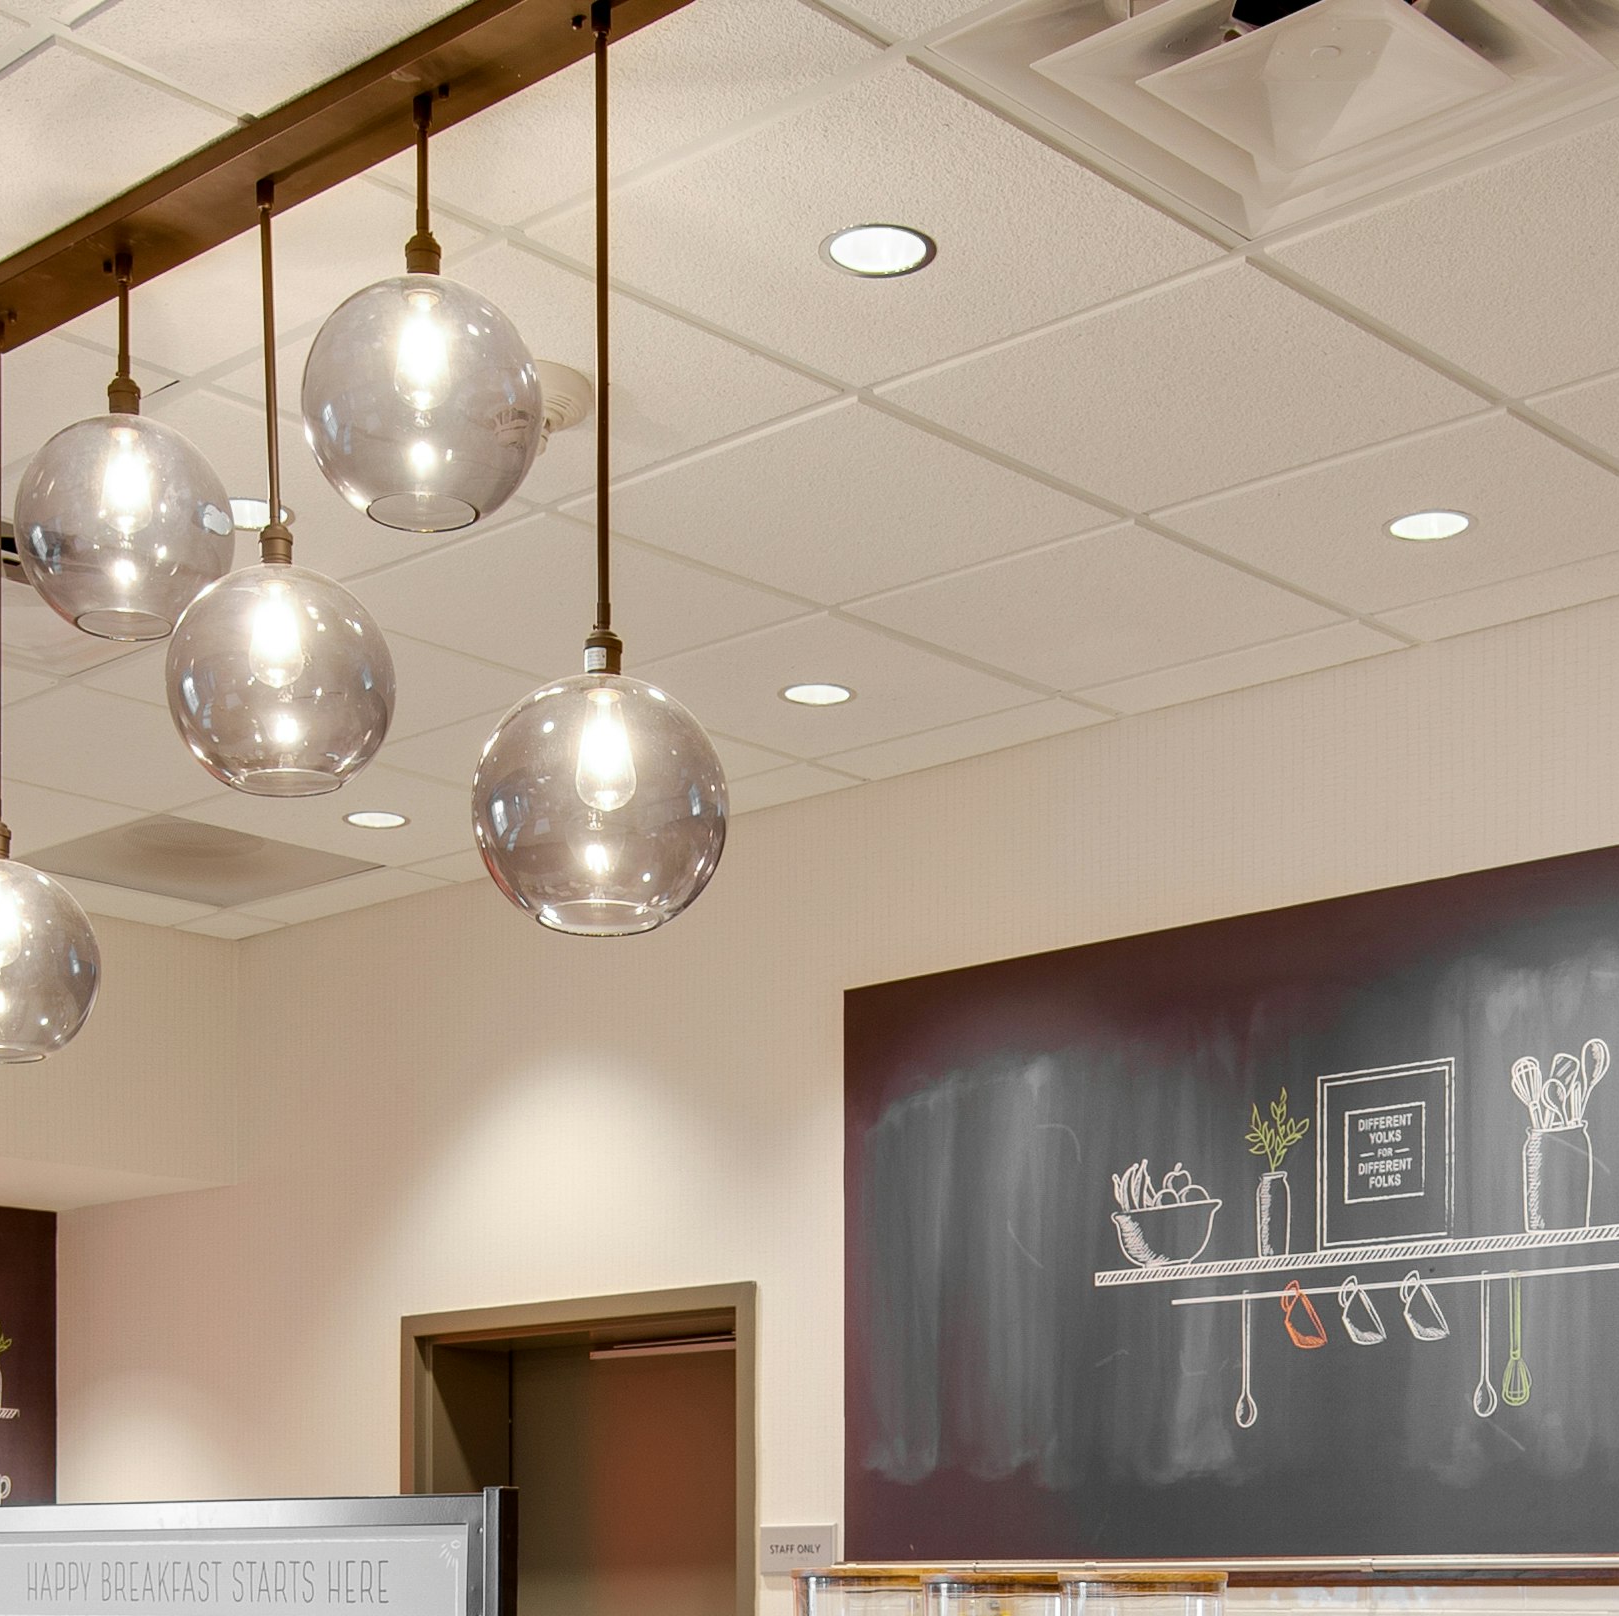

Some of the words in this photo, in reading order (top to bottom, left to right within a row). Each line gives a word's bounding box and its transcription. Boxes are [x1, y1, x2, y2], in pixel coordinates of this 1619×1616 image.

[1358, 1113, 1413, 1132] DIFFERENT
[1369, 1129, 1402, 1144] YOLKS
[1377, 1147, 1393, 1157] FOR
[1358, 1157, 1413, 1176] DIFFERENT
[1369, 1173, 1402, 1189] FOLKS
[770, 1544, 795, 1554] STAFF
[797, 1543, 821, 1554] ONLY
[27, 1561, 91, 1601] HAPPY
[101, 1561, 222, 1602] BREAKFAST
[231, 1560, 316, 1603] STARTS
[328, 1560, 390, 1604] HERE
